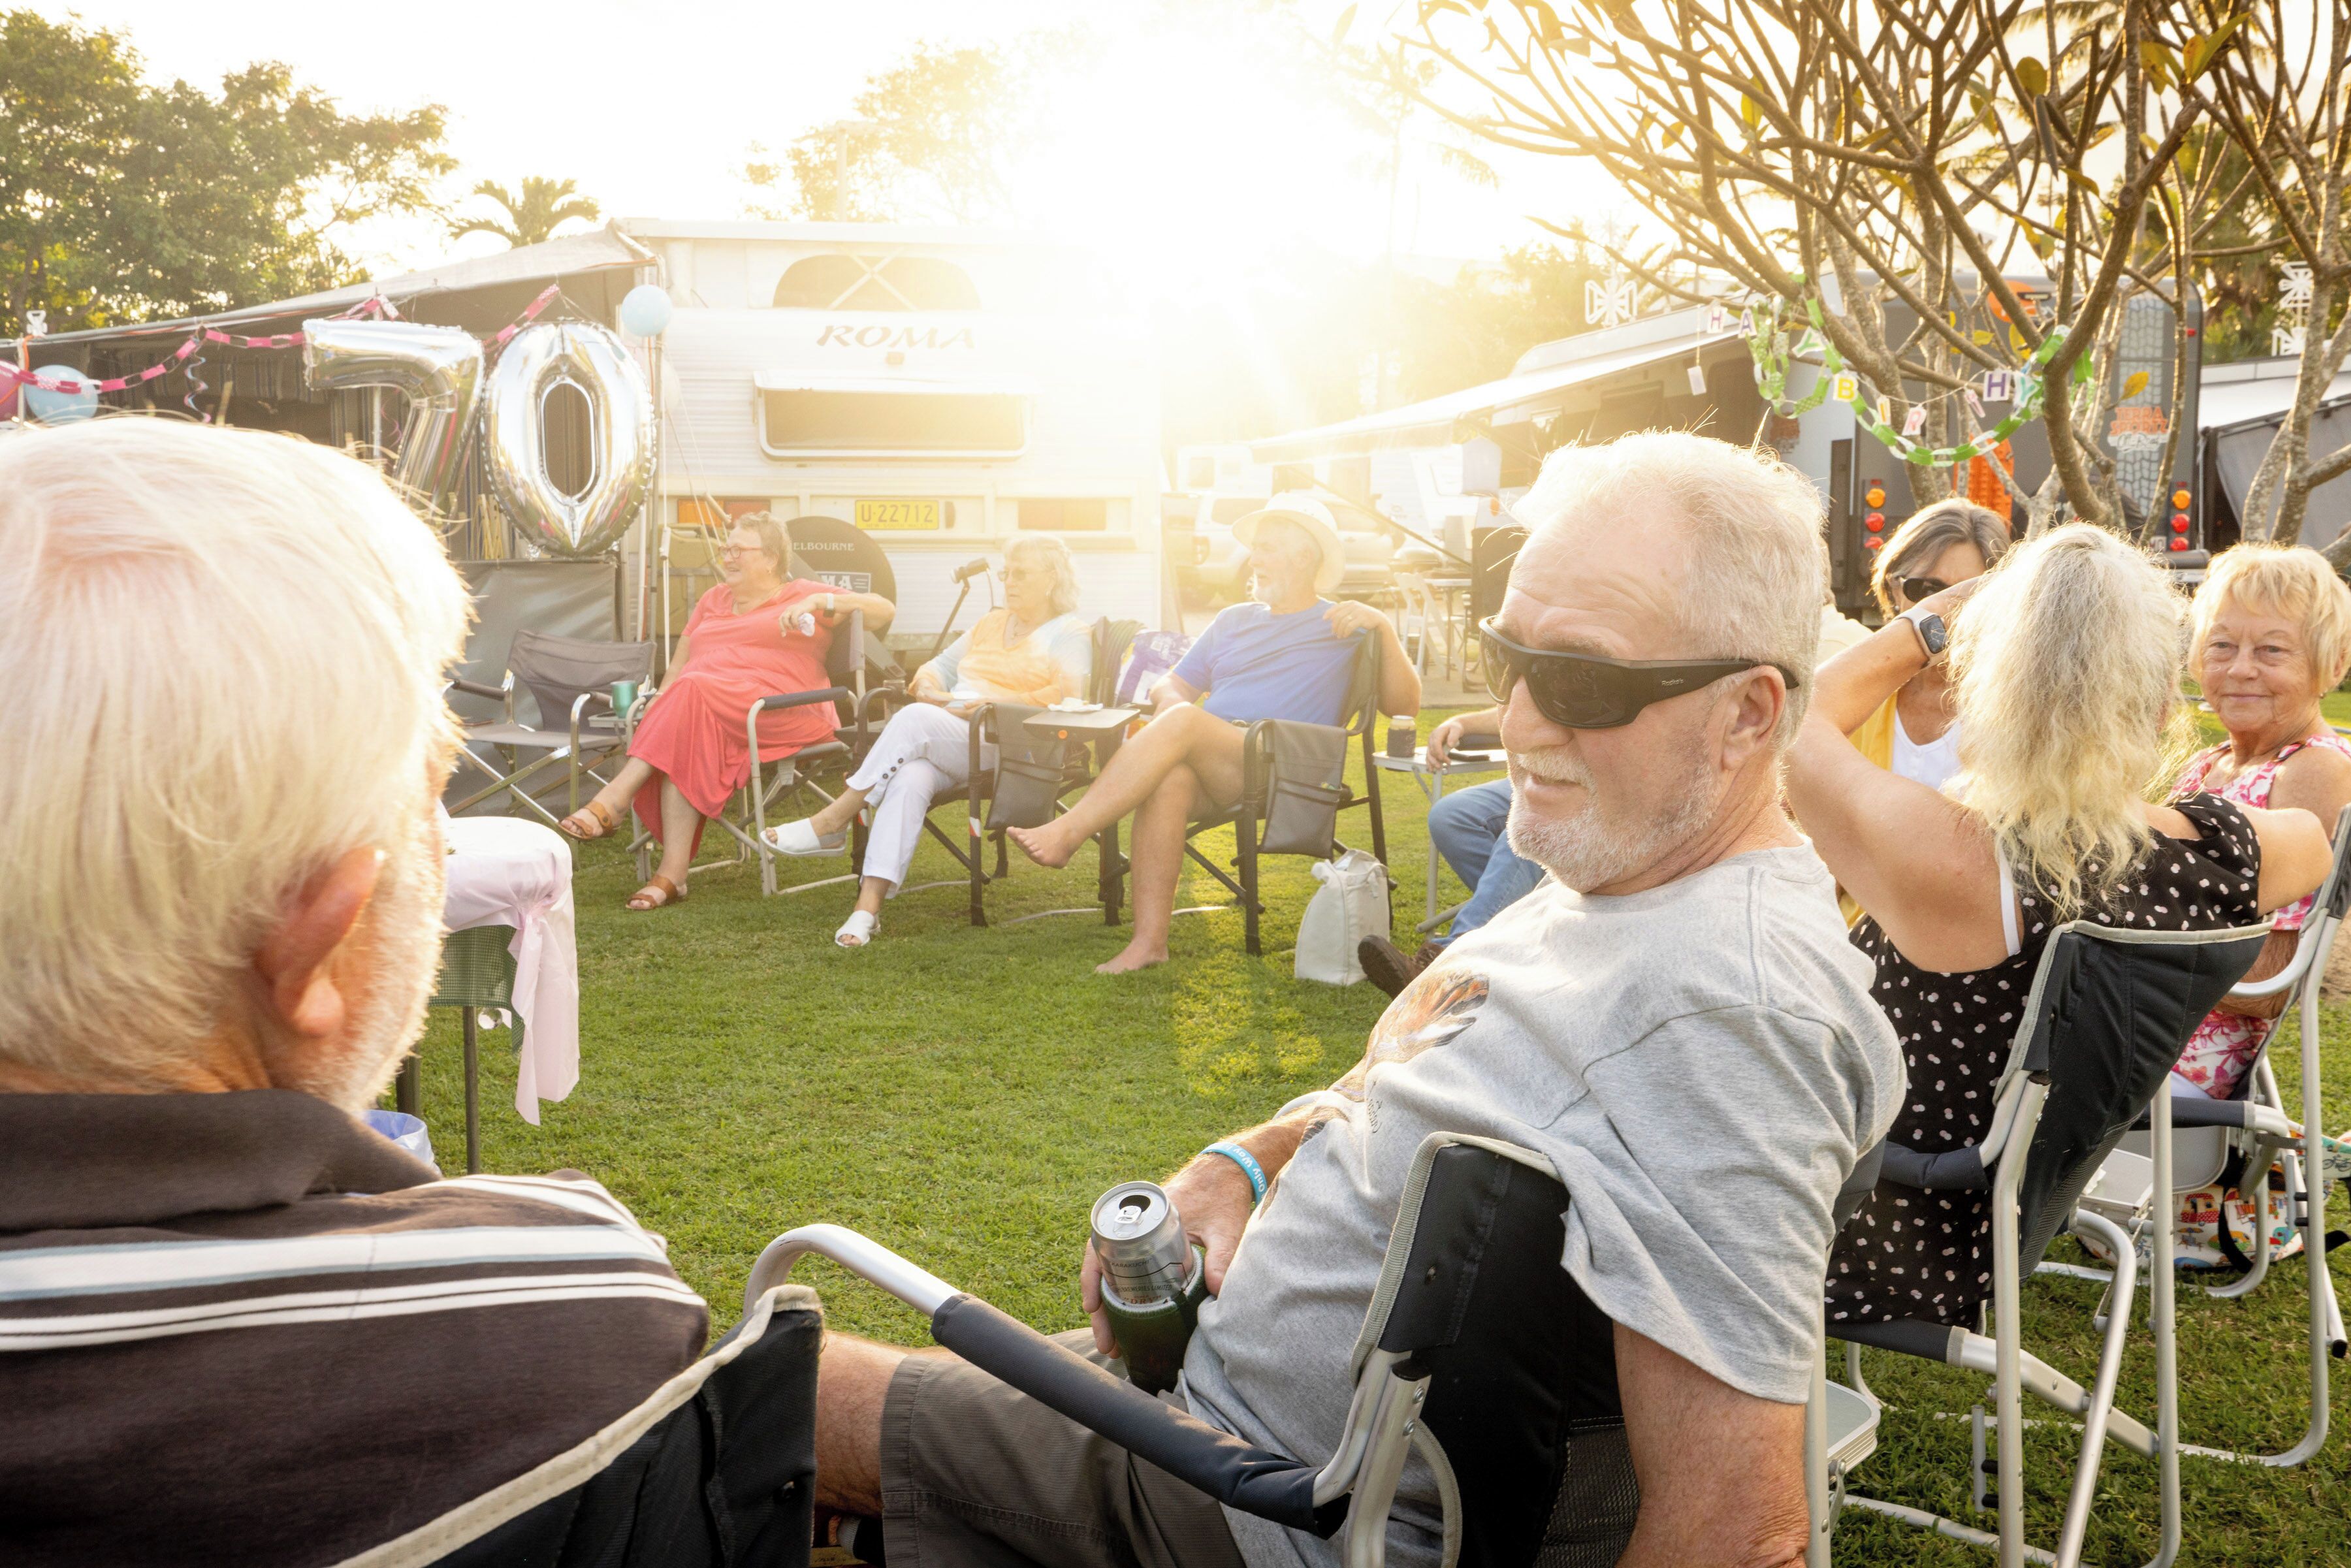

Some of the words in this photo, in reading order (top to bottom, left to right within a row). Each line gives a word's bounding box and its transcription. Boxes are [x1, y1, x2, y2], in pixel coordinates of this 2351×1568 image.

[816, 325, 974, 349] ROMA
[2115, 406, 2164, 420] TERRA
[302, 317, 657, 559] 70
[1232, 1148, 1253, 1168] Way
[1253, 1168, 1265, 1192] Only
